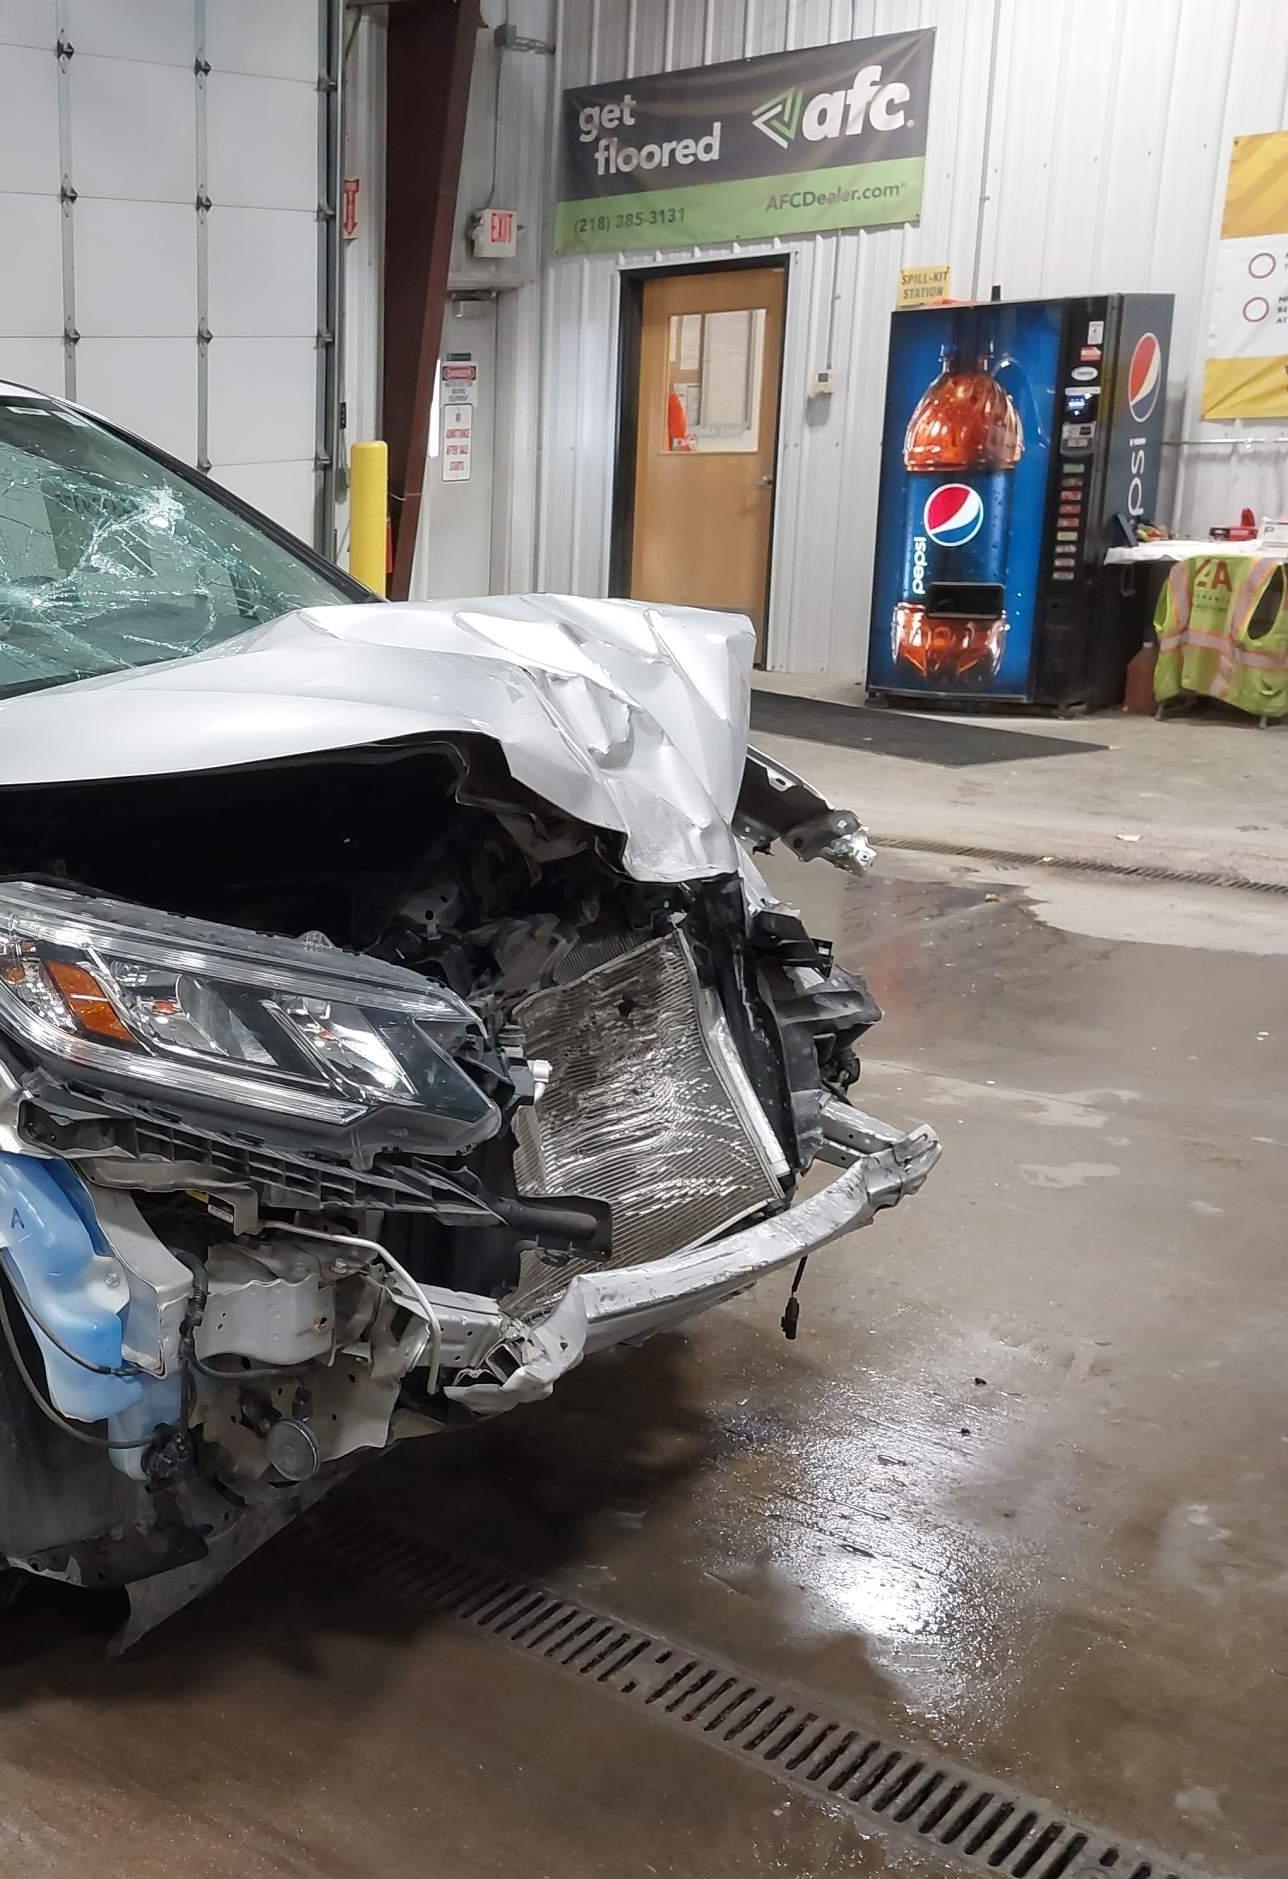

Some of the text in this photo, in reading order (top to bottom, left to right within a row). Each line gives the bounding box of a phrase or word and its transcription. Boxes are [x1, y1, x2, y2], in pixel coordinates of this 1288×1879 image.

[579, 94, 637, 142] get
[595, 121, 722, 175] floored
[765, 183, 901, 213] AFCDealer.com
[574, 206, 686, 234] (218) 385-3131
[901, 271, 949, 285] SPILL-KIT
[903, 286, 944, 300] STATION
[1128, 437, 1147, 516] psi
[912, 536, 928, 595] pepsi
[11, 1207, 25, 1229] A
